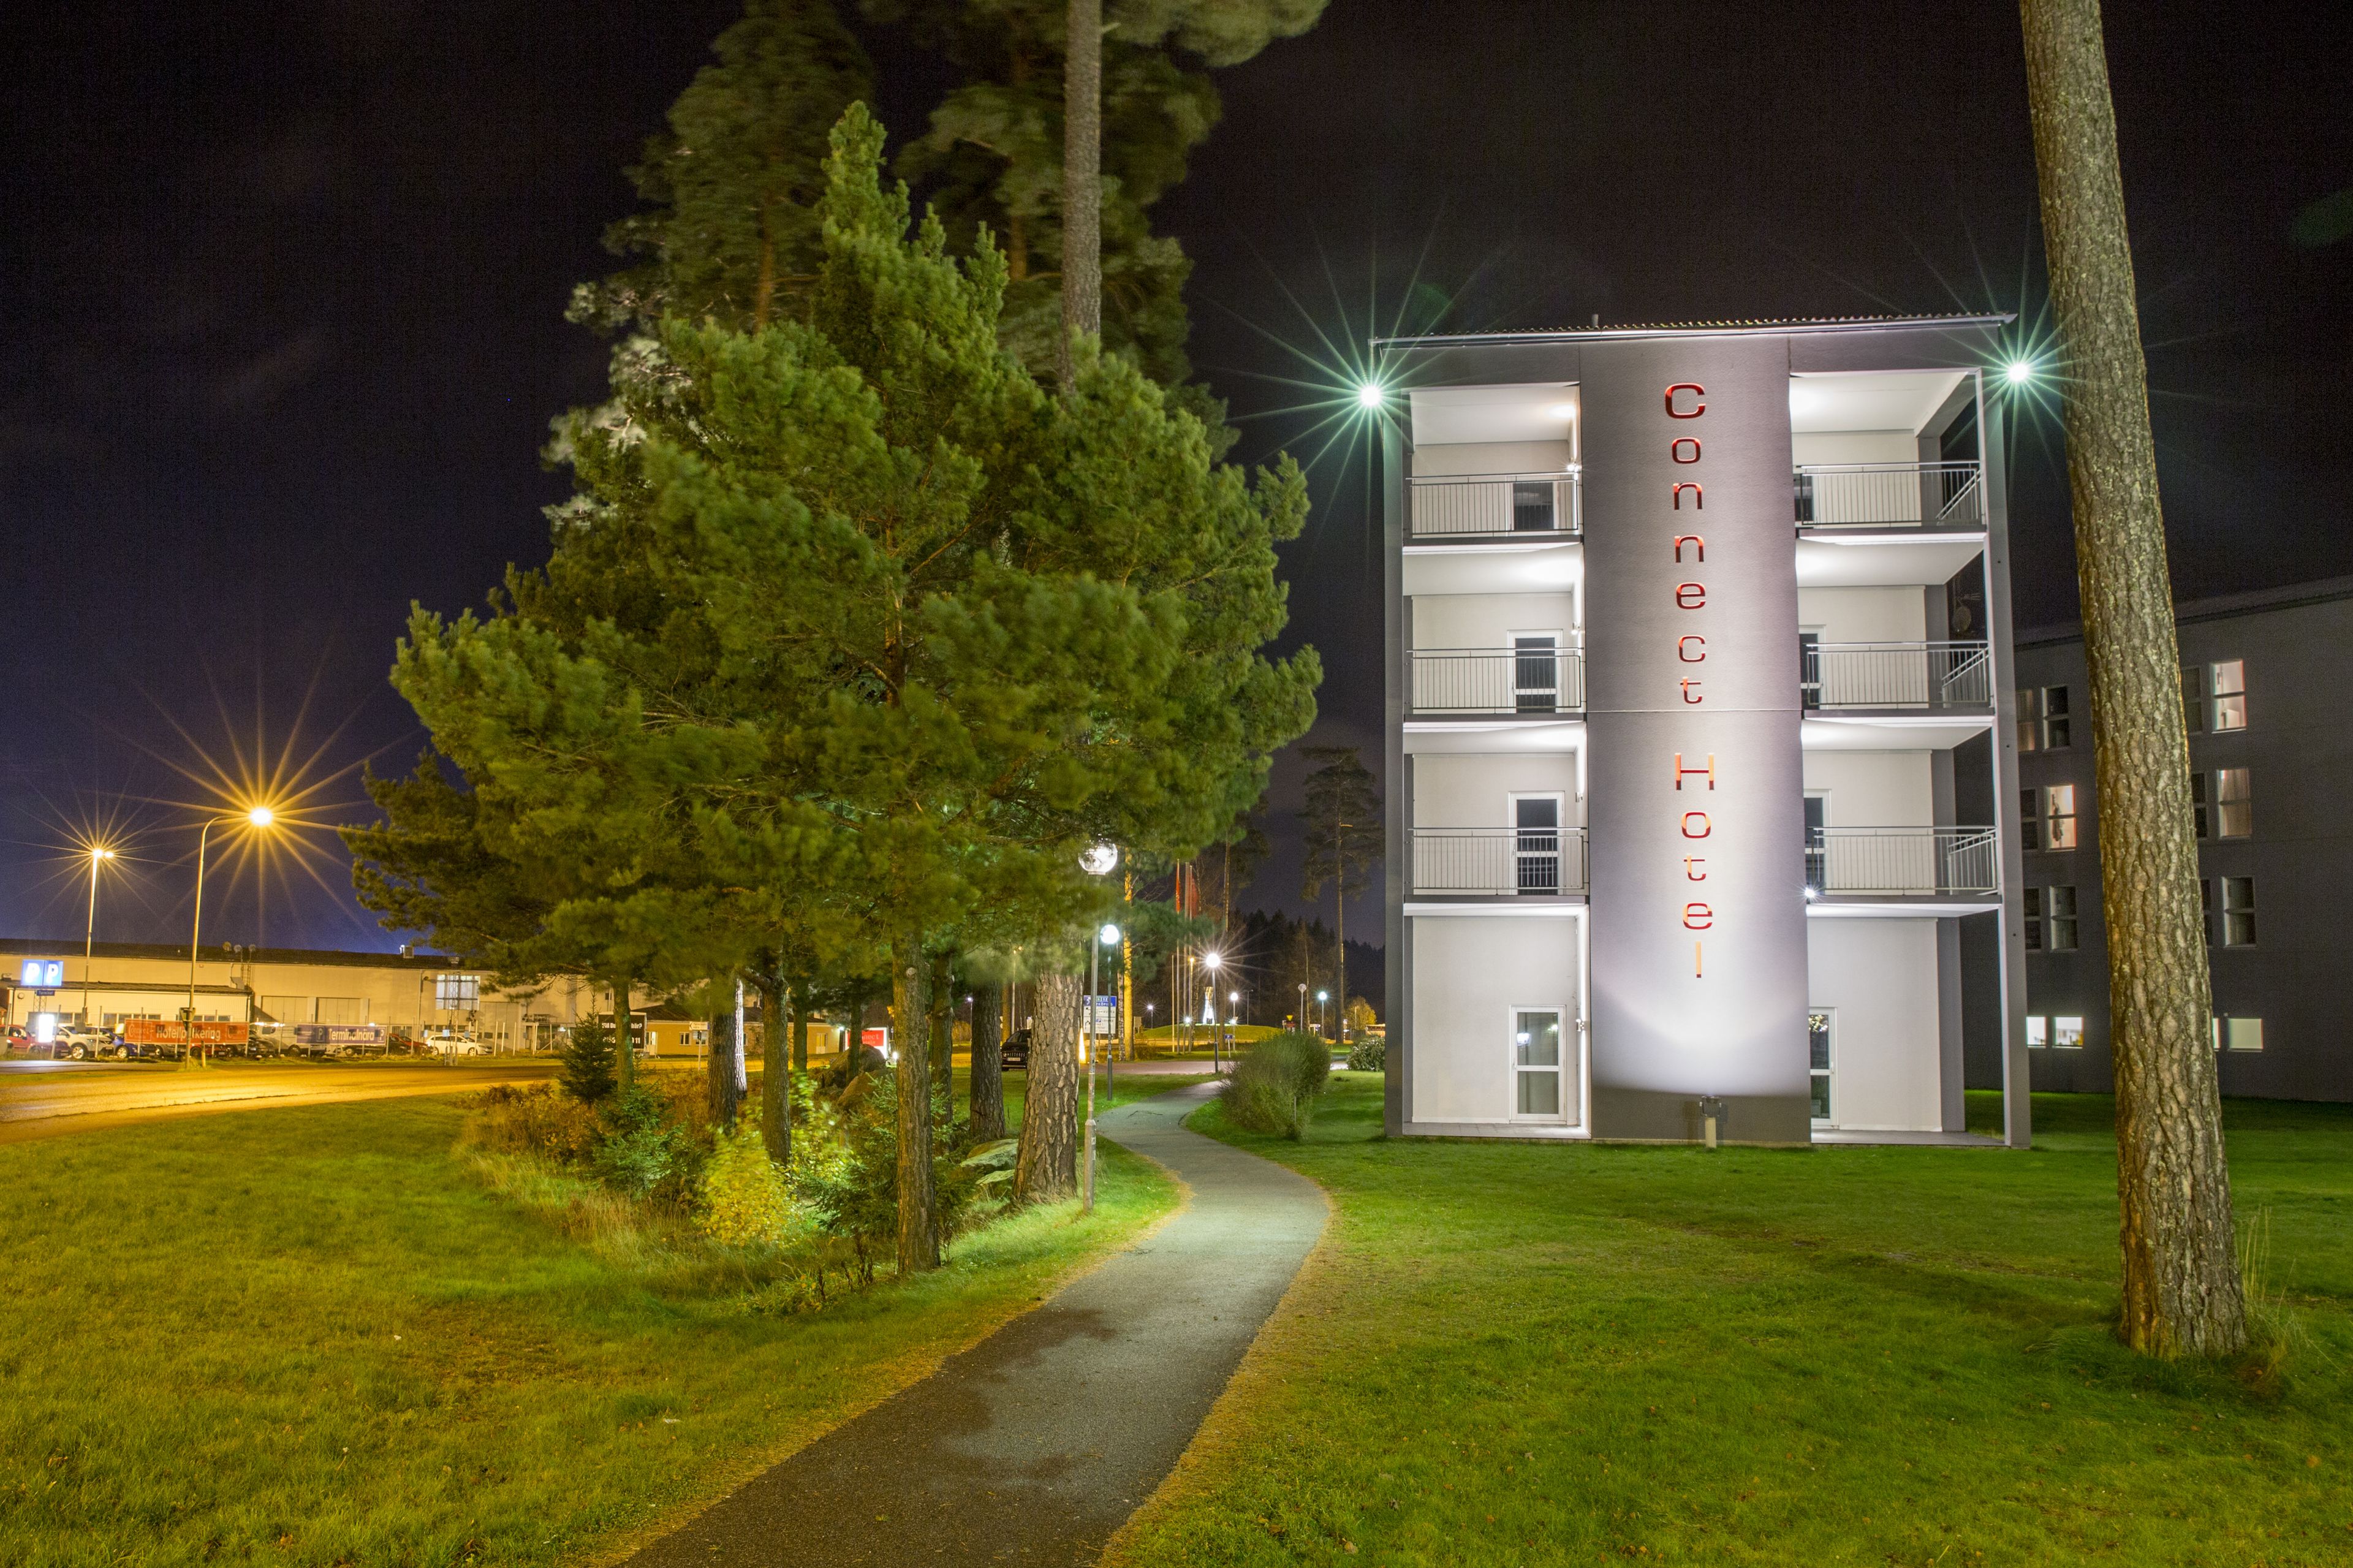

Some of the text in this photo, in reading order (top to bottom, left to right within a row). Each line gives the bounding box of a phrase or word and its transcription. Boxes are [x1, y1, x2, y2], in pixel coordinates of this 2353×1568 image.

[1665, 382, 1714, 978] Connect Hotel
[25, 963, 40, 983] P
[46, 964, 59, 983] P
[156, 1026, 221, 1042] Hotellprkering
[328, 1028, 374, 1041] Terminalnära
